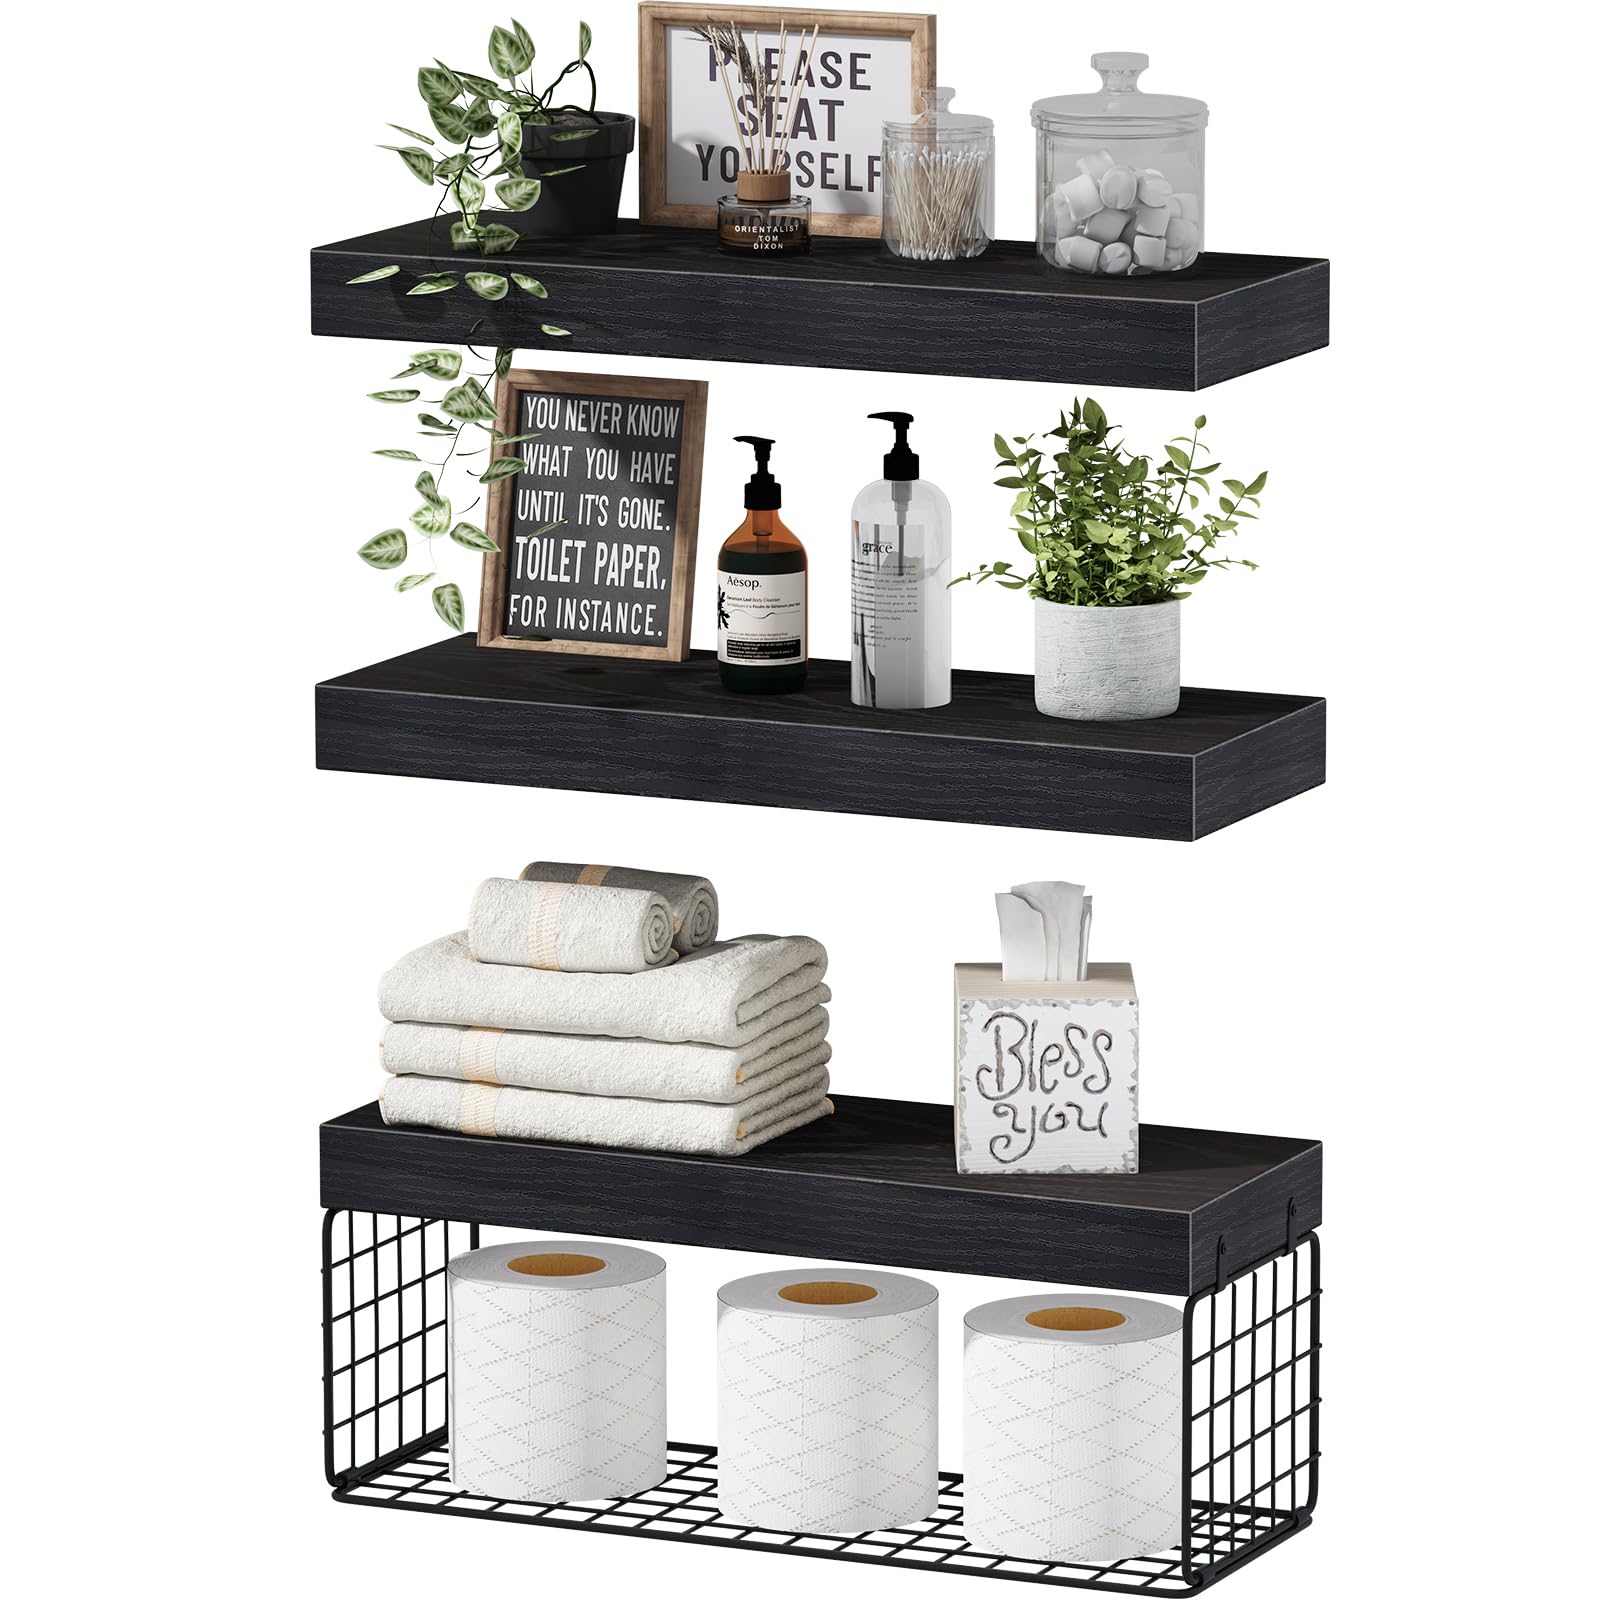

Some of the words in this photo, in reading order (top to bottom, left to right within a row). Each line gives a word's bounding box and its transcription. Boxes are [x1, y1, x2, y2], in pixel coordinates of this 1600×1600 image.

[708, 45, 871, 91] PEASE
[736, 94, 845, 142] SEAT
[734, 224, 799, 233] ORIENTALIST
[753, 242, 784, 250] DIXON
[526, 396, 561, 430] YOU
[565, 399, 621, 434] NEVER
[626, 403, 680, 438] KNOW
[522, 442, 573, 478] WHAT
[586, 447, 619, 481] YOU
[629, 450, 676, 485] HAVE
[517, 488, 568, 524] UNTIL
[578, 493, 609, 527] IT'S
[617, 496, 670, 531] GONE.
[515, 535, 587, 584] TOILET
[593, 541, 666, 590] PAPER,
[862, 542, 893, 556] grace
[508, 594, 547, 628] FOR
[555, 597, 662, 637] INSTANCE.
[976, 1011, 1112, 1101] Bless
[989, 1101, 1109, 1164] you
